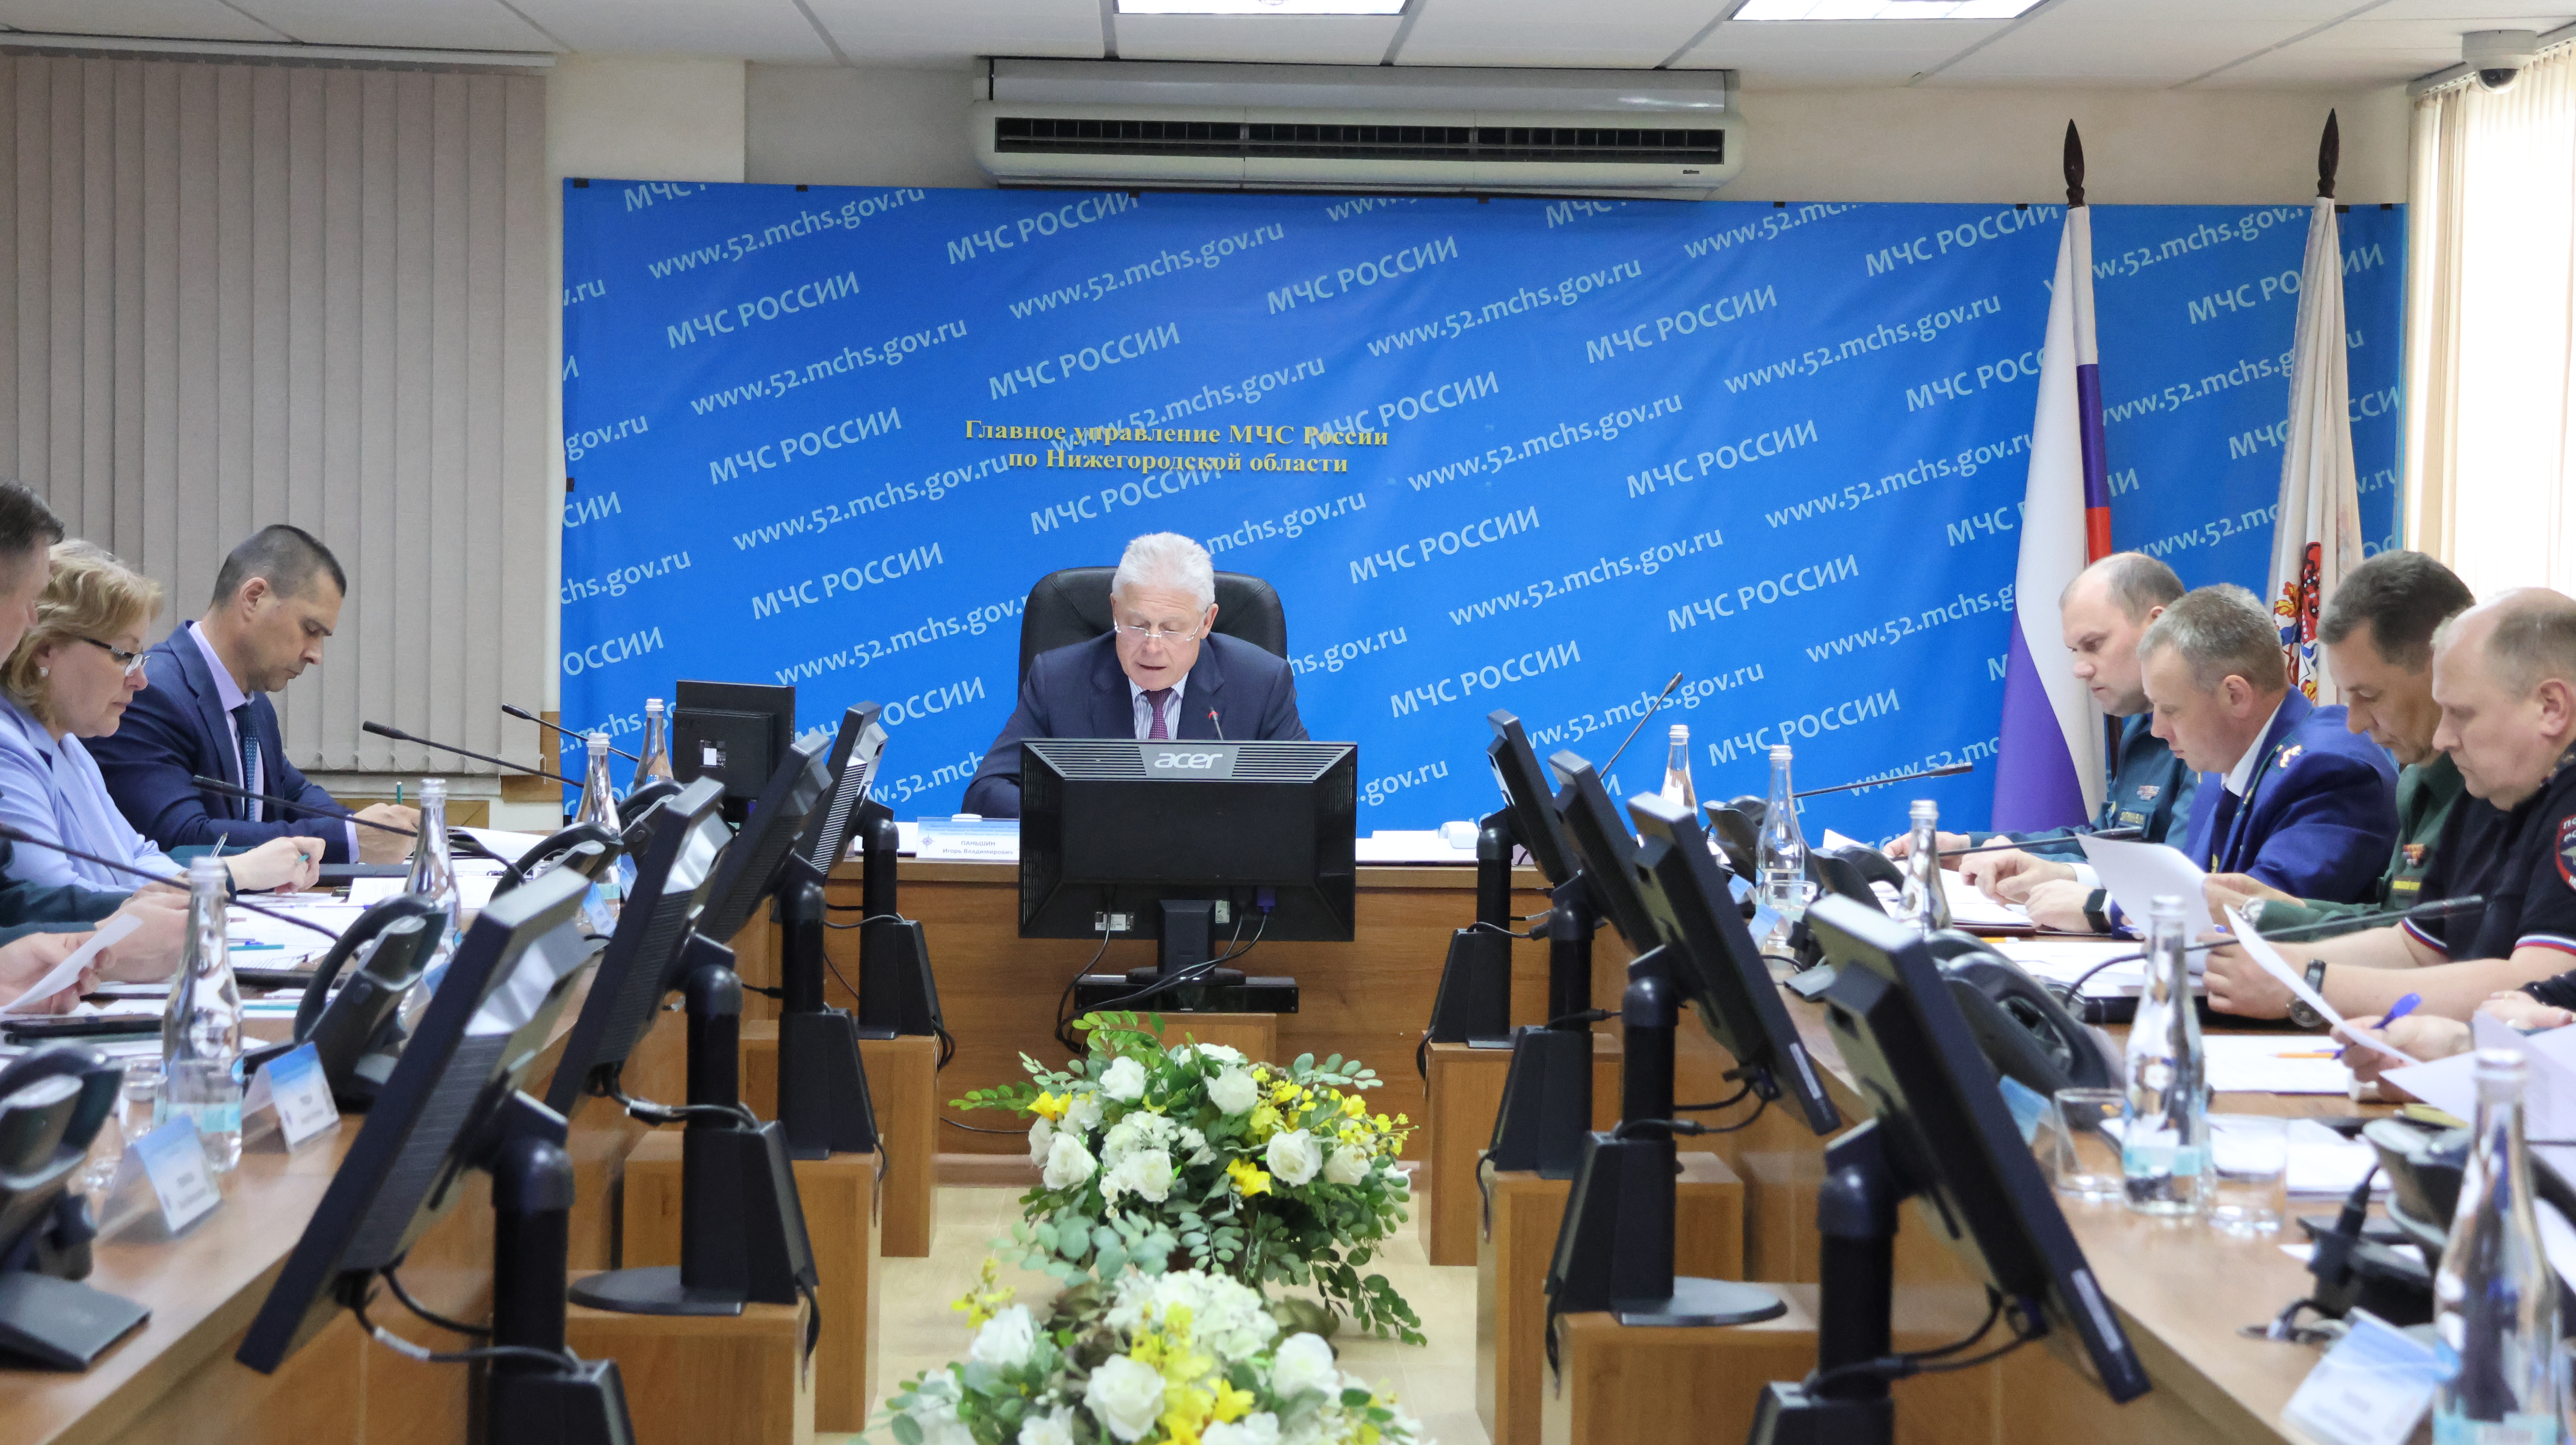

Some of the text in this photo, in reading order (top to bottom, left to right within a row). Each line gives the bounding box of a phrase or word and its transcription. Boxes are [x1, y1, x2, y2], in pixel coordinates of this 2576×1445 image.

[947, 224, 1014, 265] МЧС
[1009, 224, 1284, 319] www.52.mchs.gov.ru
[1267, 235, 1458, 315] МЧС РОССИИ
[1865, 237, 1933, 277] МЧС
[667, 271, 860, 349] МЧС РОССИИ
[1367, 259, 1642, 357] www.52.mchs.gov.ru
[1586, 284, 1777, 364] МЧС РОССИИ
[2187, 284, 2256, 325] МЧС
[690, 319, 967, 416] www.52.mchs.gov.ru
[989, 322, 1180, 400] МЧС РОССИИ
[1724, 295, 2001, 394] www.52.mchs.gov.ru
[1308, 371, 1499, 450] МЧС РОССИИ
[1905, 371, 1973, 412] МЧС
[709, 406, 902, 485] МЧС РОССИИ
[965, 420, 1388, 445] Главное управление МЧС России
[1009, 449, 1348, 474] по Нижегородской области
[1407, 394, 1683, 492] www.52.mchs.gov.ru
[1626, 419, 1818, 499] МЧС РОССИИ
[732, 455, 1009, 551] www.52.mchs.gov.ru
[1030, 457, 1222, 535] МЧС РОССИИ
[1946, 507, 2013, 547] МЧС
[751, 542, 944, 620] МЧС РОССИИ
[1349, 505, 1540, 584] МЧС РОССИИ
[1448, 529, 1724, 626] www.52.mchs.gov.ru
[1667, 554, 1859, 633] МЧС РОССИИ
[1390, 639, 1581, 718] МЧС РОССИИ
[1154, 753, 1223, 769] acer
[1708, 688, 1900, 767] МЧС РОССИИ
